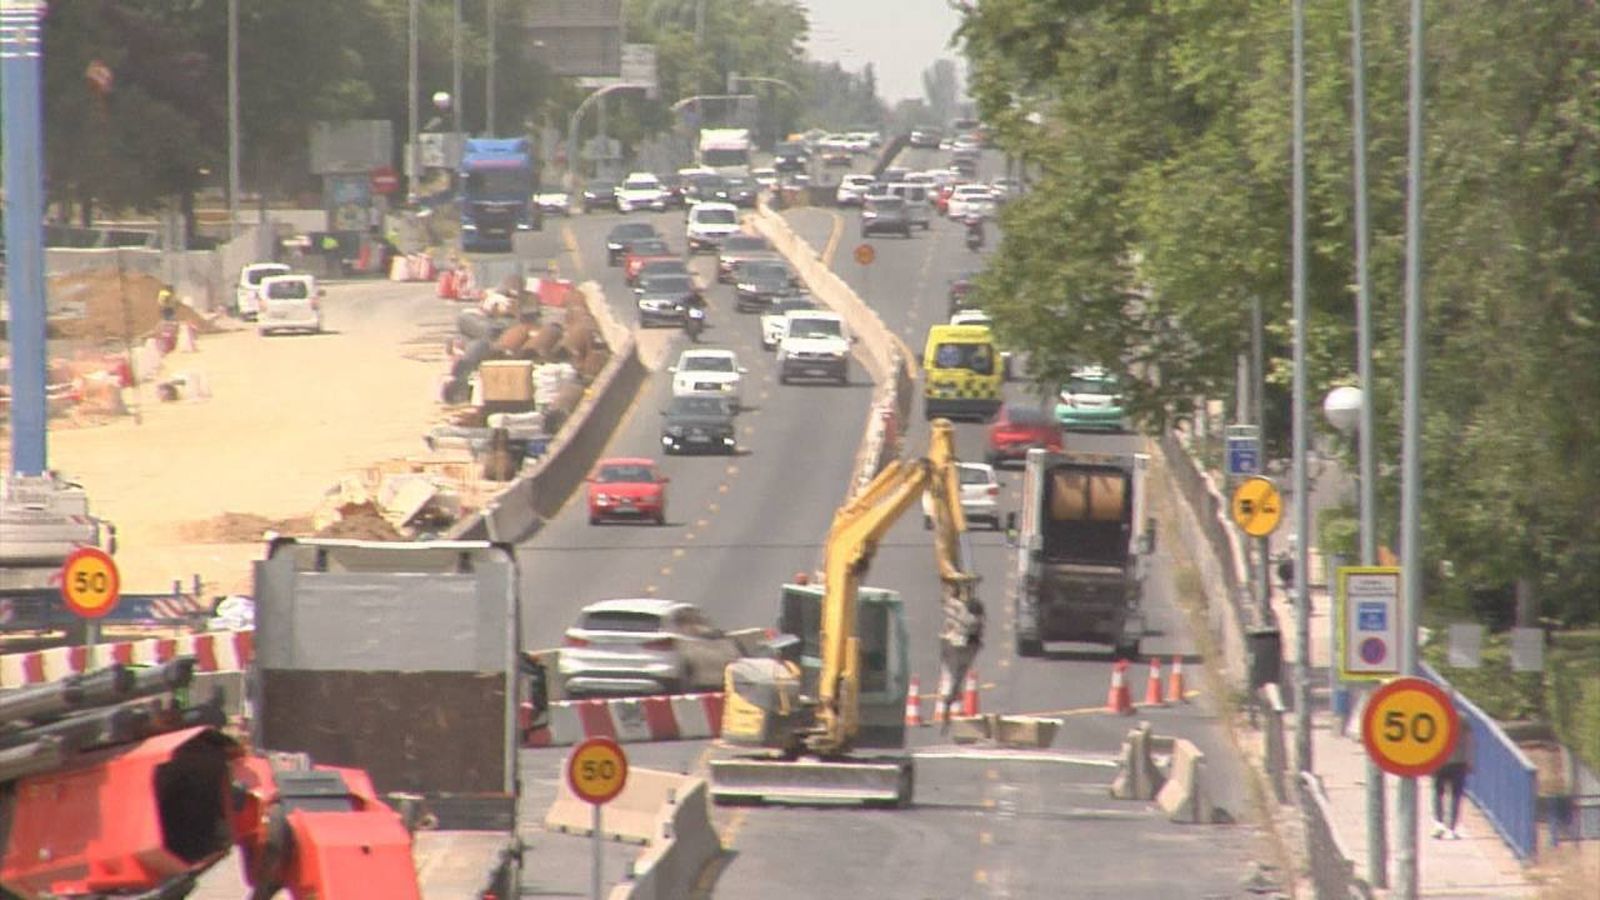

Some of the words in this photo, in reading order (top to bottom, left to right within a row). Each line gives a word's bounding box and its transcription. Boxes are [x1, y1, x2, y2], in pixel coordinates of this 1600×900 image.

[75, 571, 107, 593] 50
[1383, 711, 1437, 743] 50
[581, 760, 614, 781] 50
